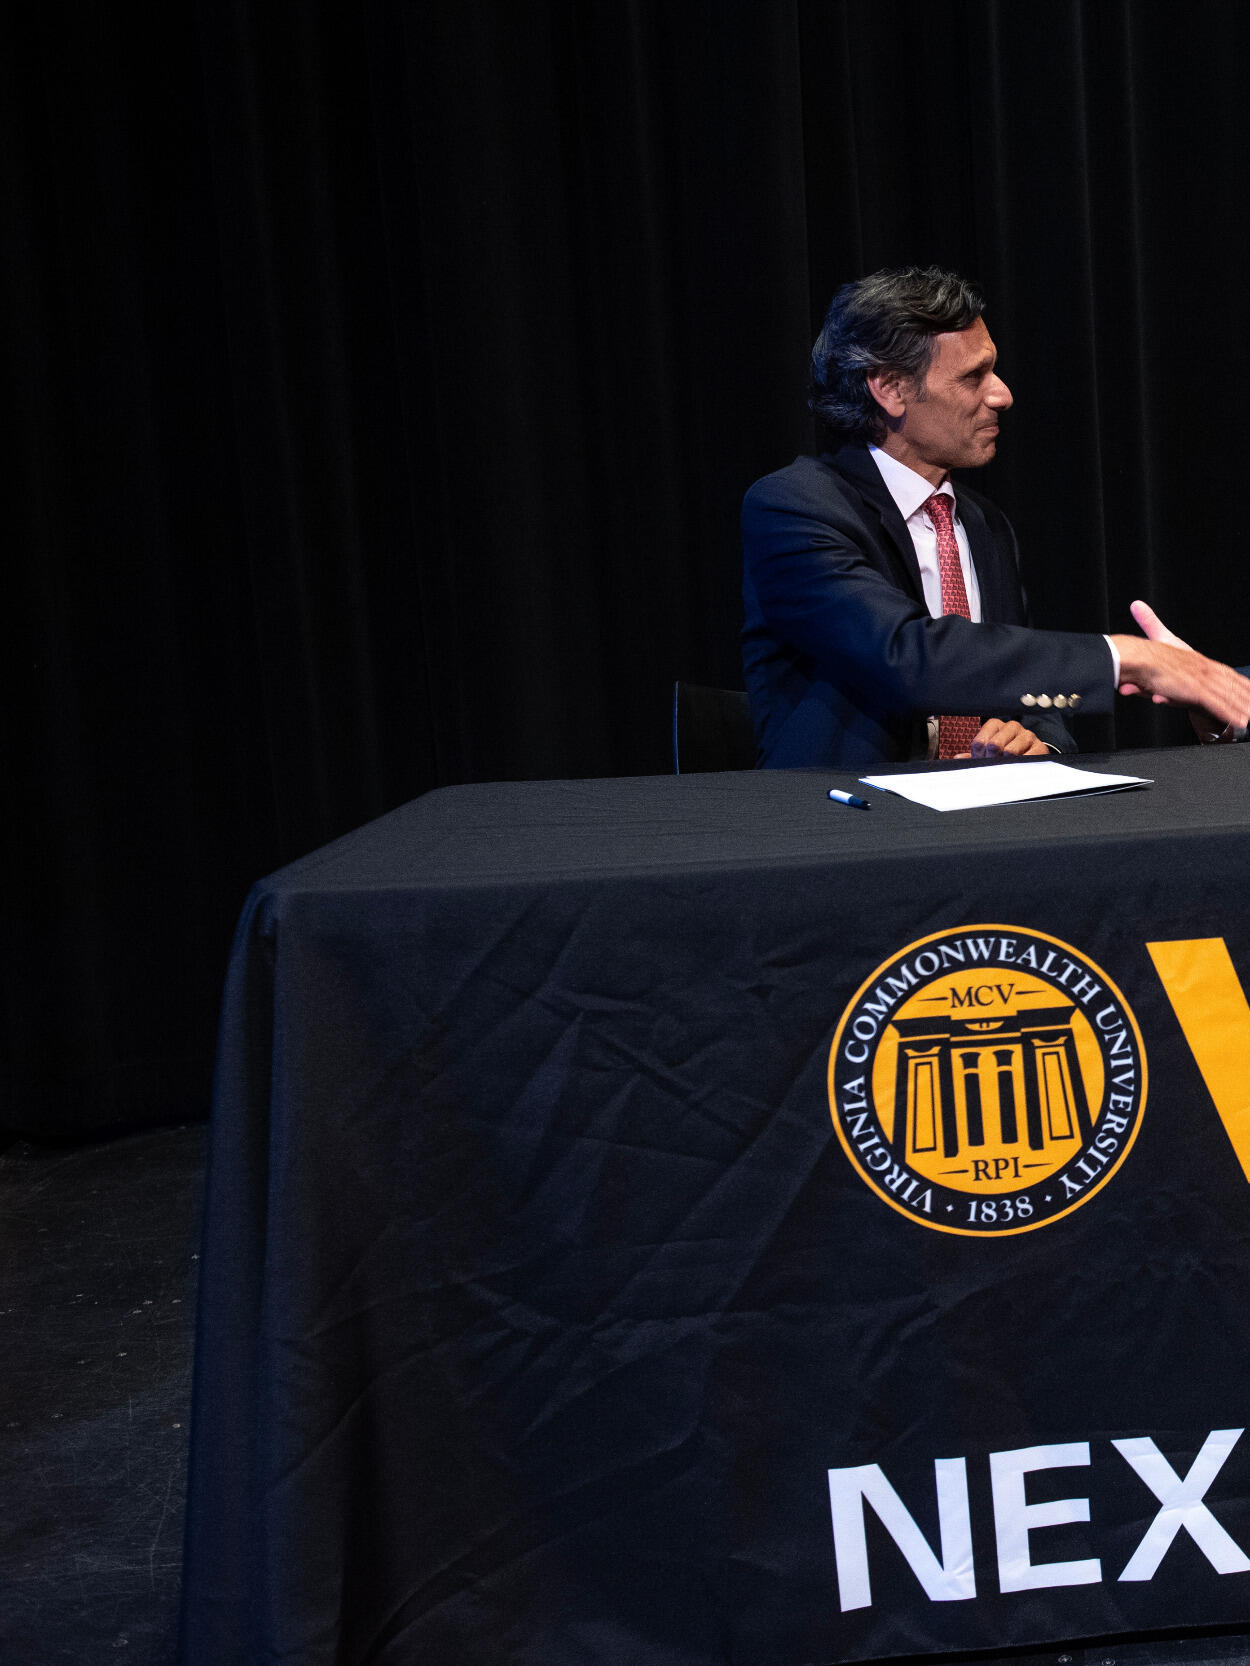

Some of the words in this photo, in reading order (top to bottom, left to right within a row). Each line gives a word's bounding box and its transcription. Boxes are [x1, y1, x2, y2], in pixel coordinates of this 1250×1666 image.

[844, 937, 1102, 1064] COMMONWEALTH
[949, 983, 1016, 1009] MCV
[1058, 1003, 1136, 1200] UNIVERSITY
[842, 1075, 932, 1213] VIRGINIA
[972, 1156, 1023, 1182] RPI
[967, 1195, 1034, 1223] 1838
